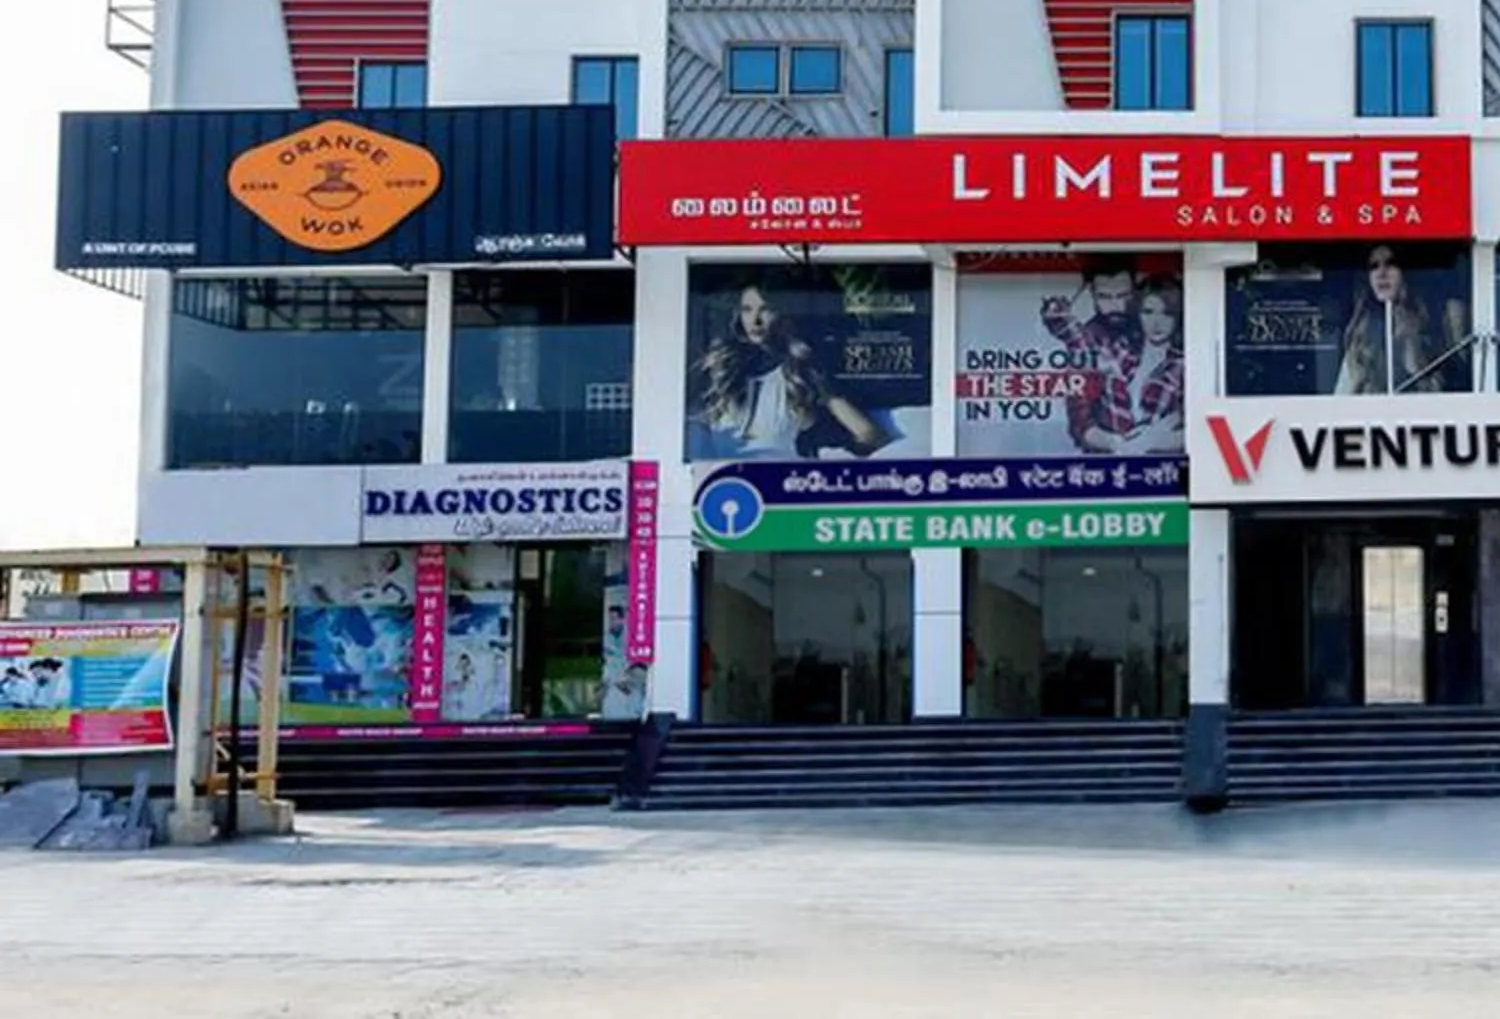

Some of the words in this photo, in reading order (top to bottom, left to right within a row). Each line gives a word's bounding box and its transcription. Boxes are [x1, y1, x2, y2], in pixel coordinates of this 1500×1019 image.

[278, 134, 389, 165] ORANGE
[952, 151, 1421, 200] LIMELITE
[301, 216, 364, 235] WOK
[1177, 205, 1294, 226] SALON
[1317, 204, 1334, 225] &
[1359, 203, 1423, 225] SPA
[966, 350, 1042, 370] BRING
[1048, 349, 1100, 370] OUT
[967, 375, 1016, 397] THE
[1020, 374, 1086, 397] STAR
[966, 401, 990, 420] IN
[999, 401, 1052, 420] YOU
[365, 487, 622, 515] DIAGNOSTICS
[813, 515, 916, 543] STATE
[926, 514, 1016, 541] BANK
[1026, 513, 1167, 540] e-LOBBY
[420, 596, 437, 698] HEALTH
